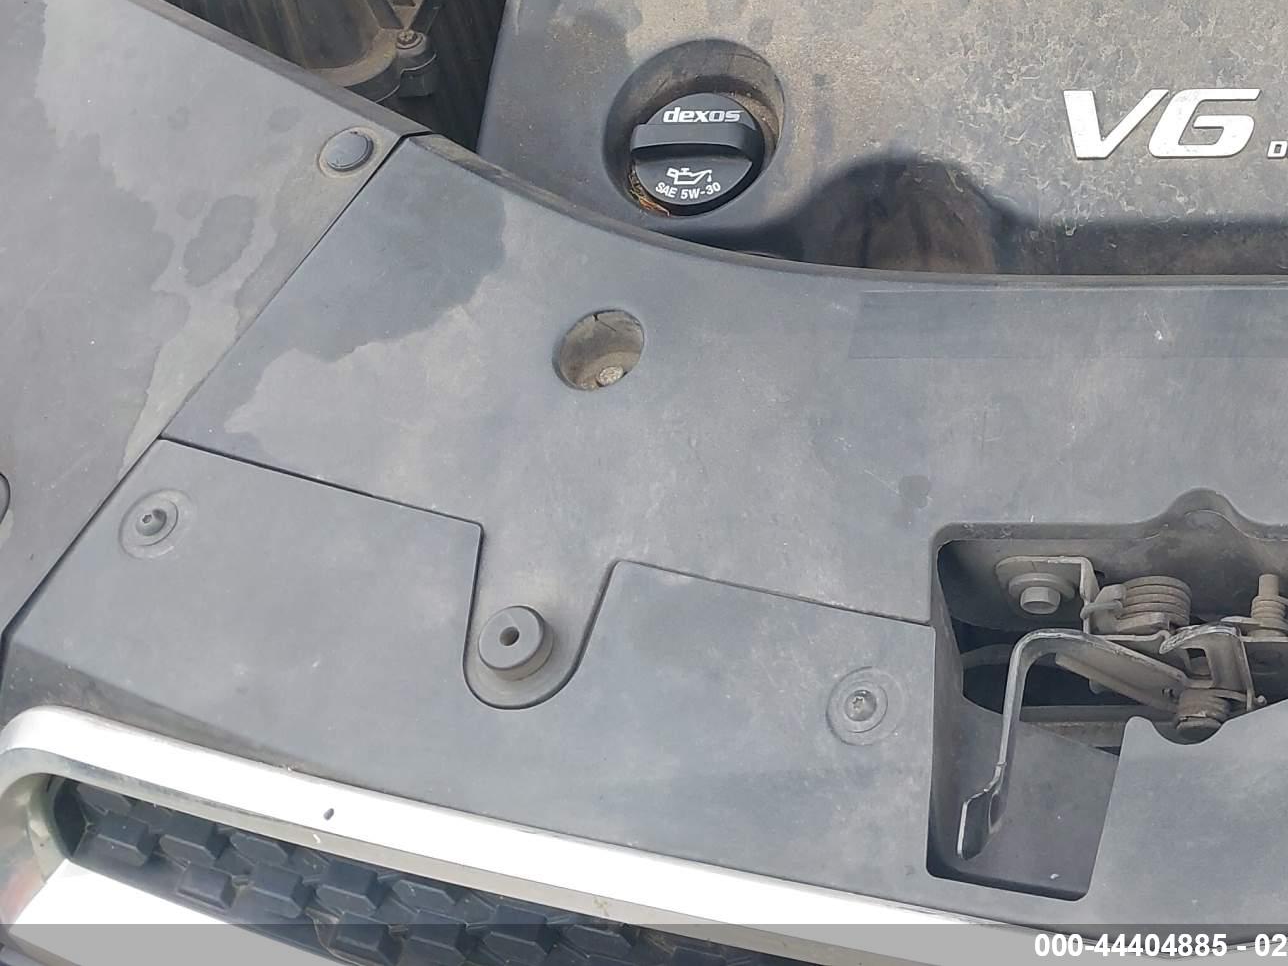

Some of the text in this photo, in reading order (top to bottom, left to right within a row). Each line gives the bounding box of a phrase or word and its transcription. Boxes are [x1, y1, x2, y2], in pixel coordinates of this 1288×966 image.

[663, 106, 744, 123] dexos
[1063, 88, 1261, 160] V6
[655, 181, 721, 200] SAE 5W-30
